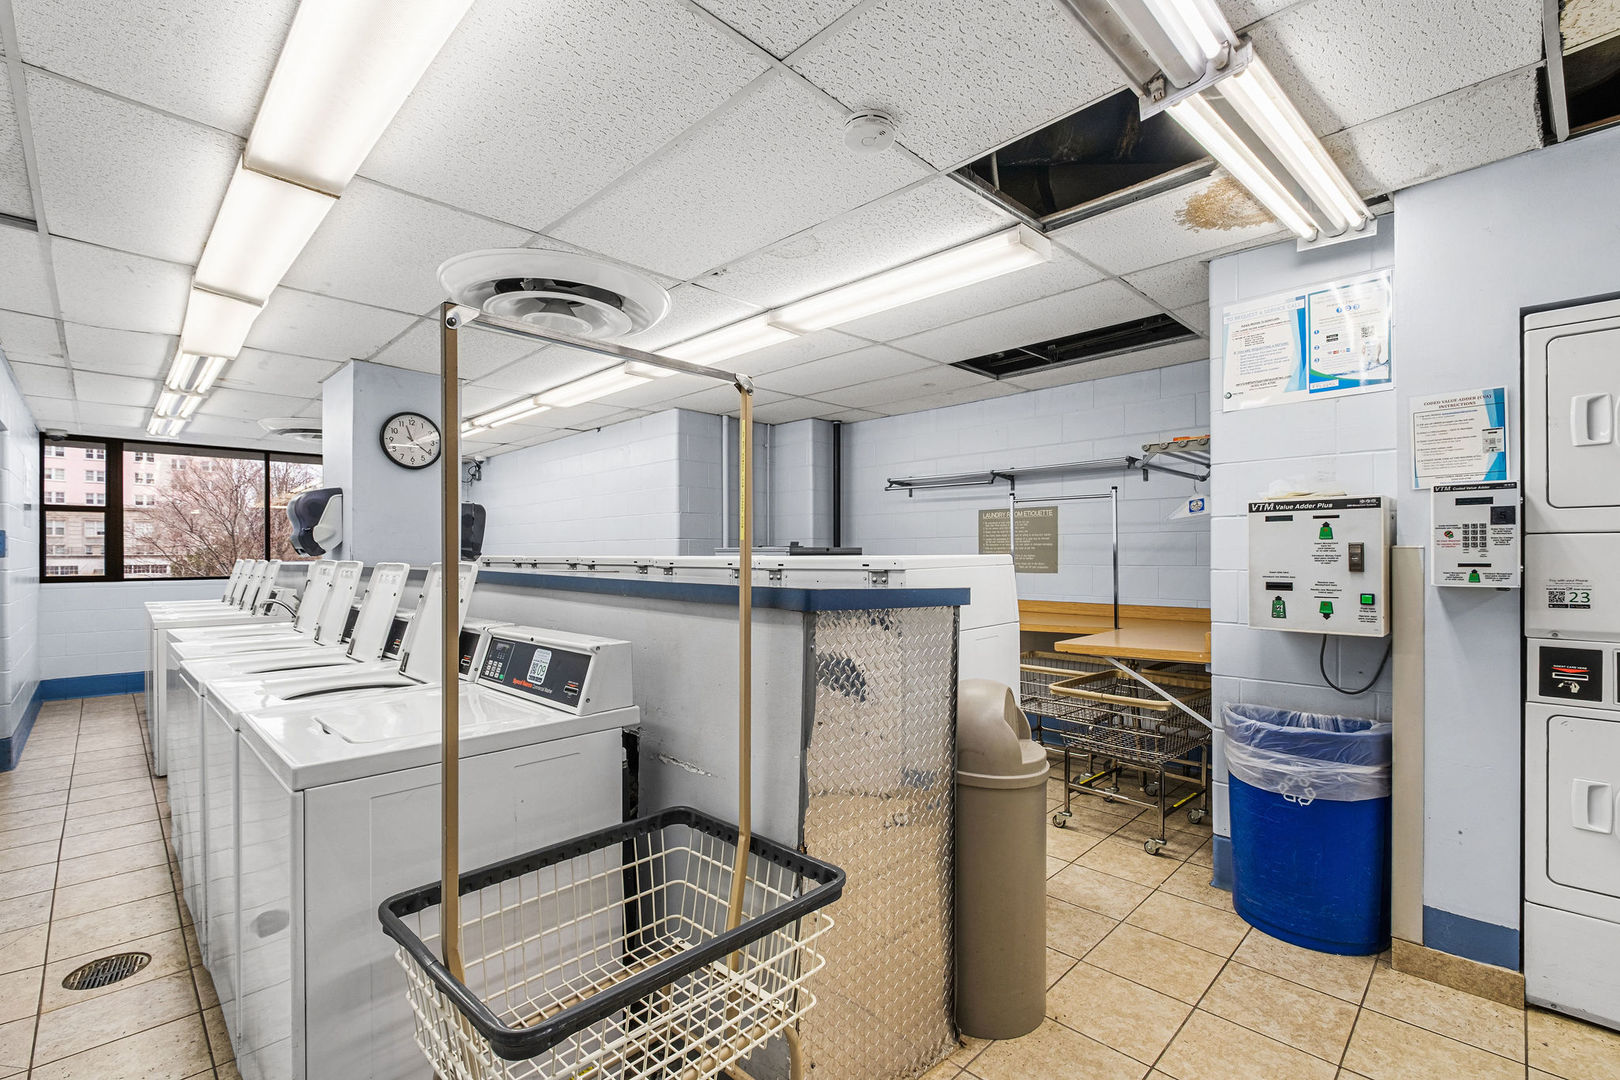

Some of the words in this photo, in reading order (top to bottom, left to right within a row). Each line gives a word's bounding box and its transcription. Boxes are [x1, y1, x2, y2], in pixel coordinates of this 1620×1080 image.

[1251, 503, 1275, 511] VTM
[1569, 592, 1590, 603] 23
[537, 665, 546, 676] 09
